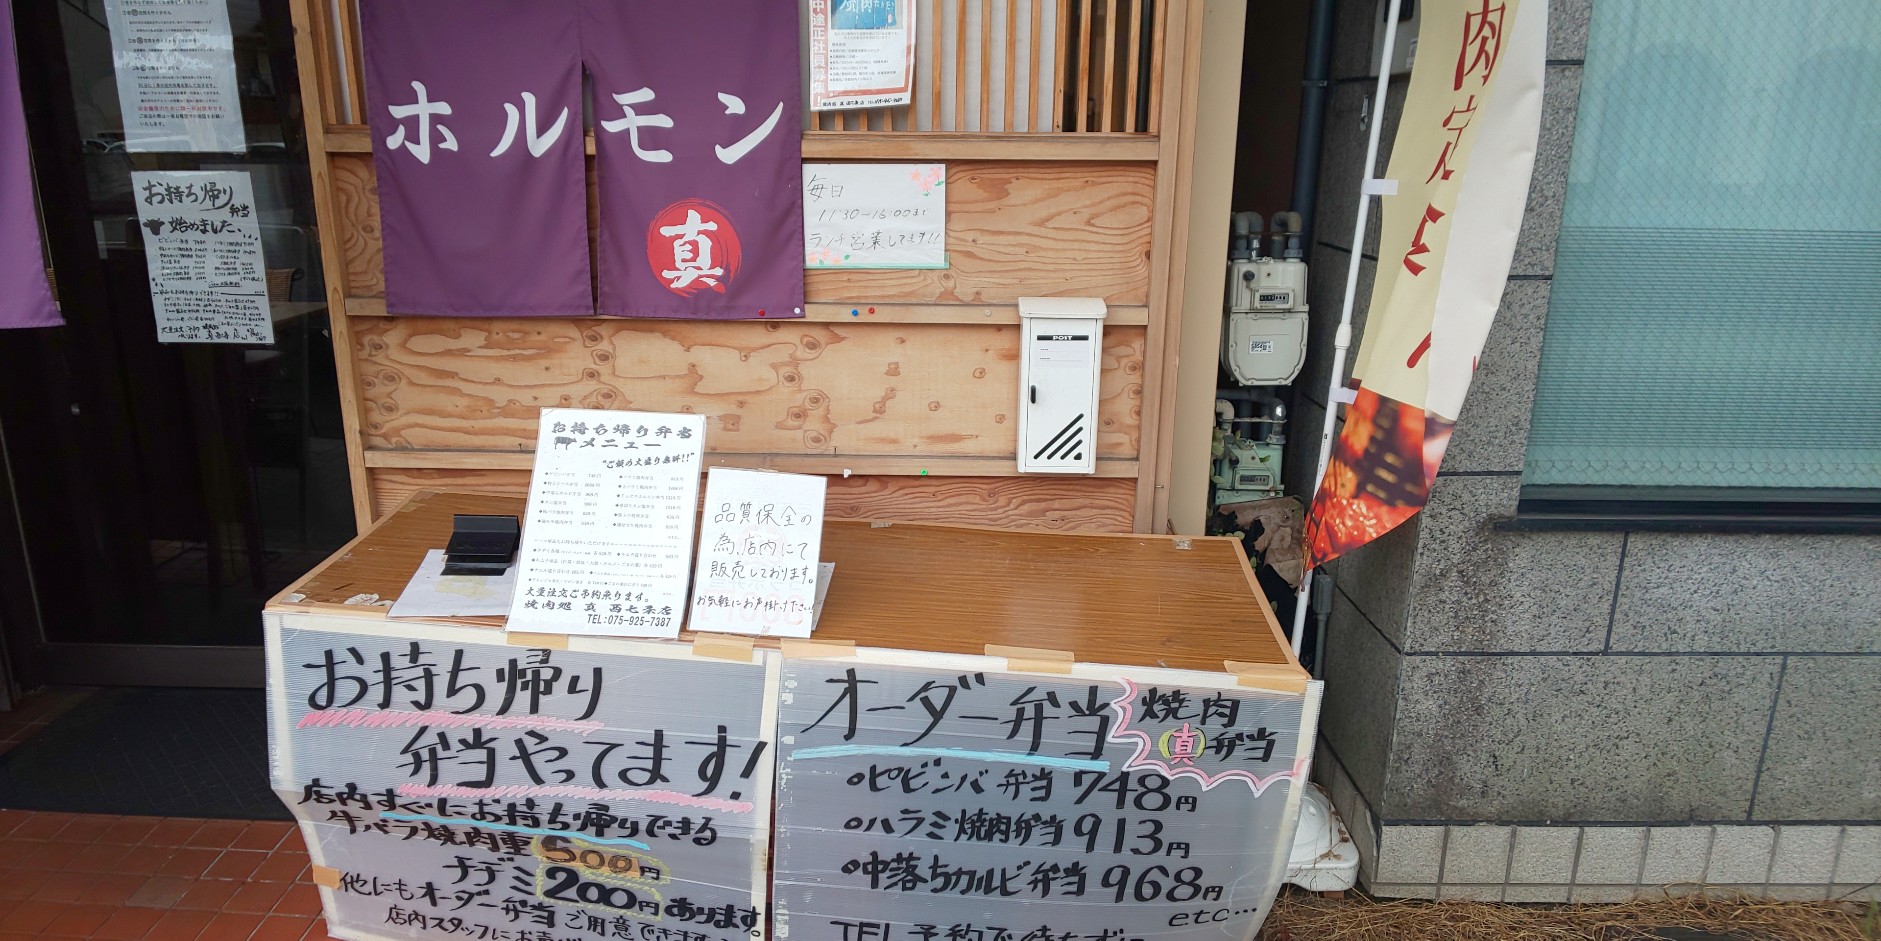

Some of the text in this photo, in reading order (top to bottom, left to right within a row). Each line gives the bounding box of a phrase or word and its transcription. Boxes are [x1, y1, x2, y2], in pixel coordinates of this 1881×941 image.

[386, 80, 784, 165] ホルモン
[142, 179, 233, 212] お持ち帰り
[807, 174, 844, 203] 毎日
[229, 203, 250, 218] 弁当
[660, 209, 724, 289] 真
[552, 421, 693, 440] お持ち帰り弁当
[579, 438, 662, 450] メニュー
[714, 501, 812, 527] 品質保全の
[710, 560, 814, 585] 販売しております。
[524, 599, 673, 616] 焼肉処 真 西七条店
[525, 586, 650, 603] 大量注文ご予約承ります。
[587, 613, 671, 628] TEL:075-925-7387
[302, 641, 604, 721] お持ち帰り
[800, 667, 1114, 759] オーダー弁当
[1139, 686, 1241, 728] 焼肉
[396, 724, 768, 801] 弁当やってます!
[297, 777, 718, 846] 店内すぐにお持ち帰りできる
[1073, 769, 1198, 813] 748円
[862, 807, 1190, 858] ハラミ焼肉弁当 913円
[862, 850, 1224, 903] 中落ちカルビ弁当 968円
[543, 866, 661, 916] 200円
[664, 897, 762, 938] あります。
